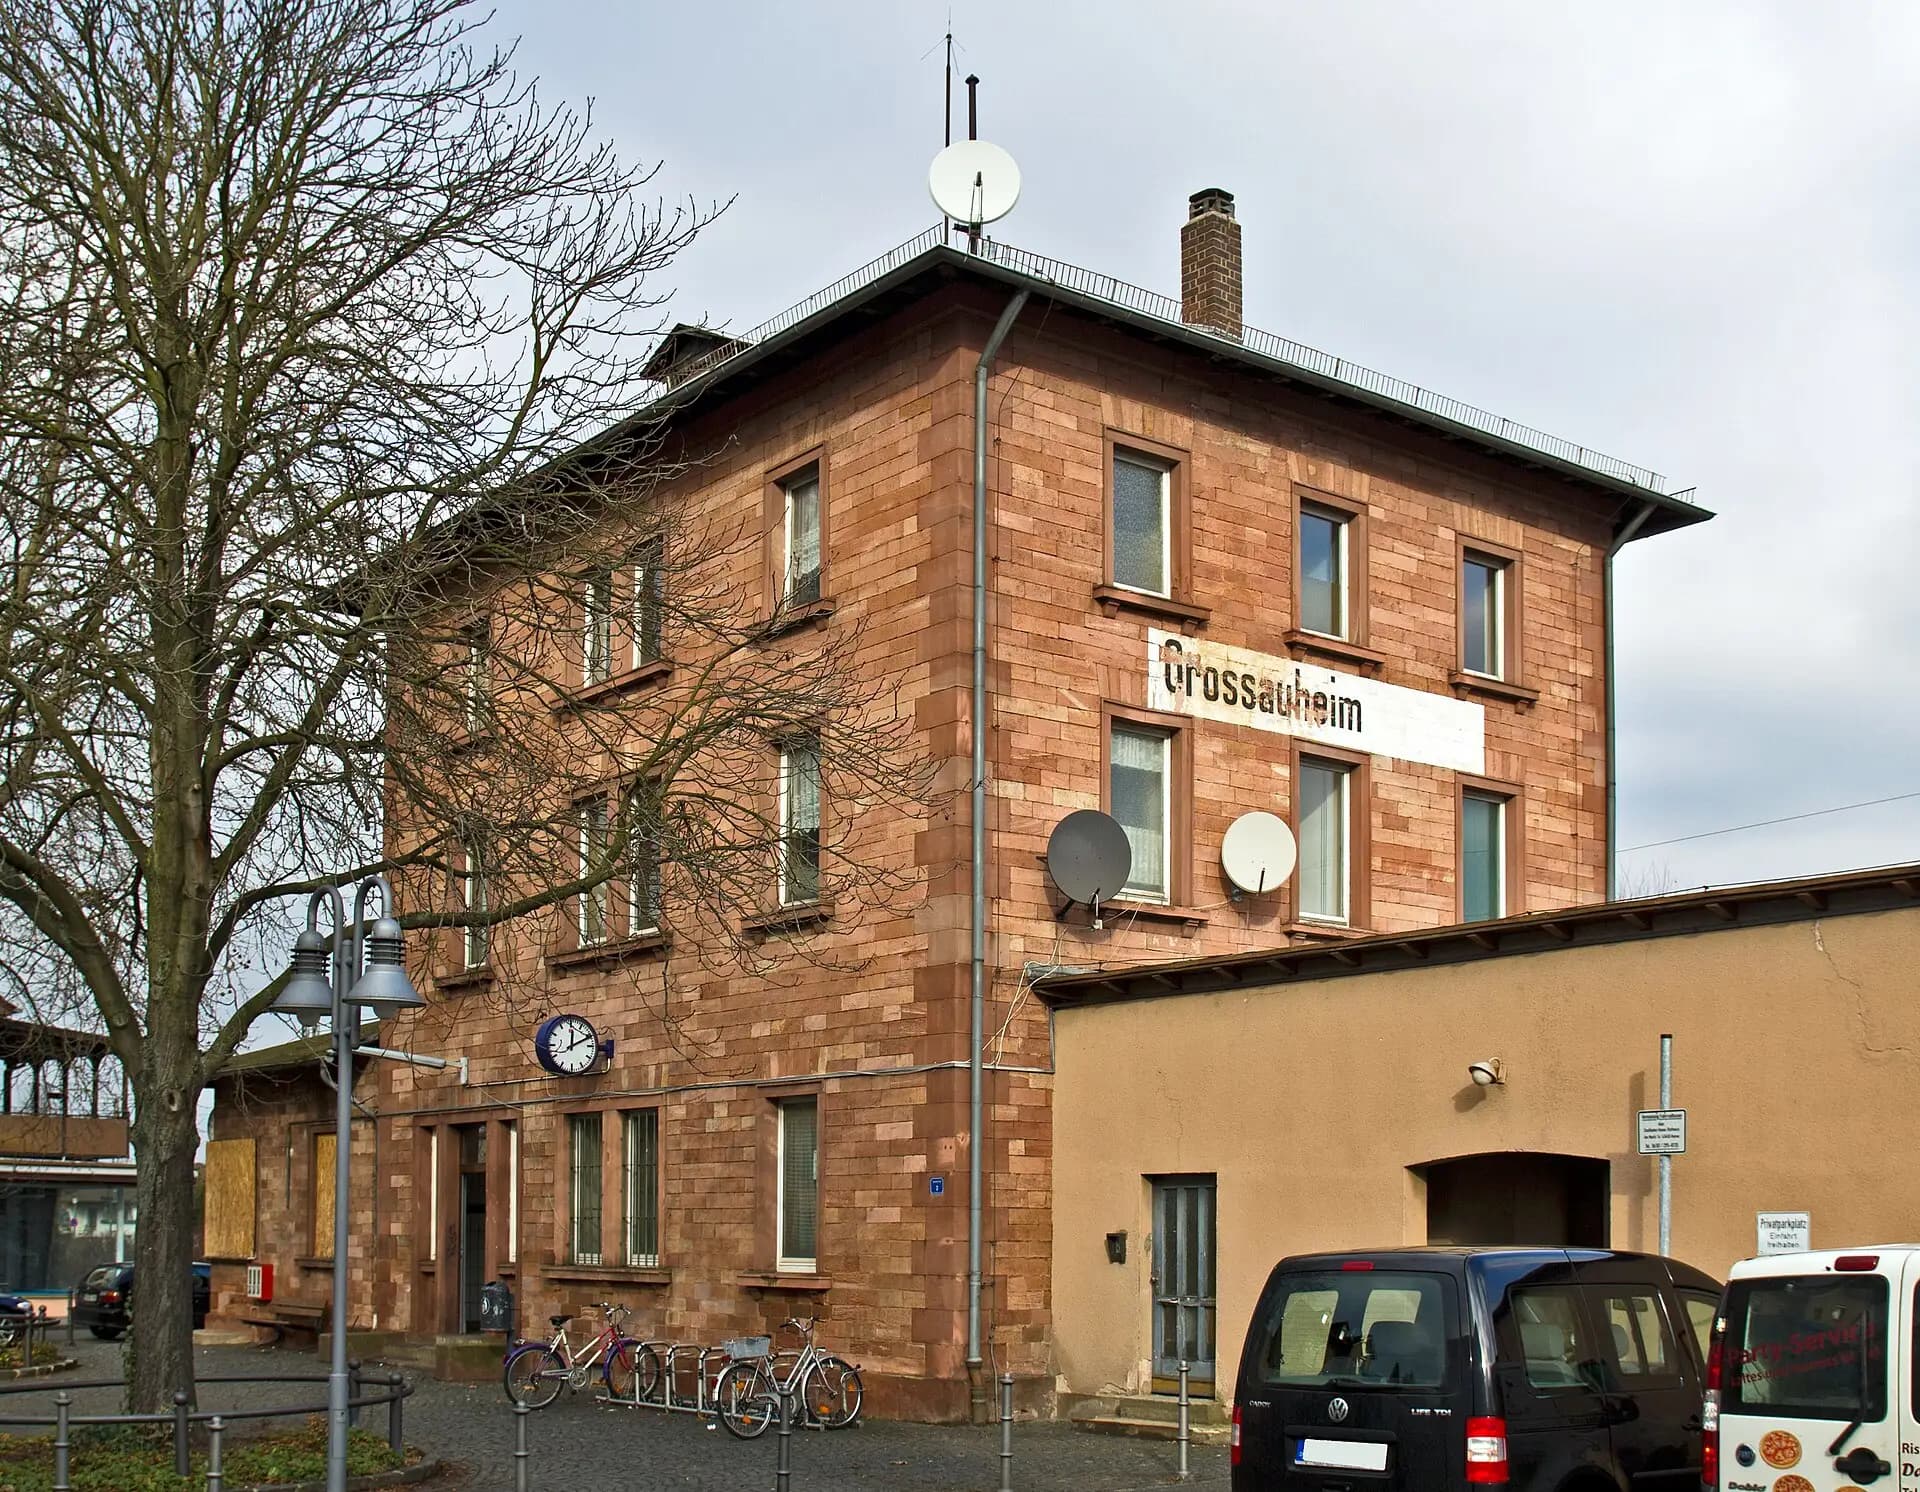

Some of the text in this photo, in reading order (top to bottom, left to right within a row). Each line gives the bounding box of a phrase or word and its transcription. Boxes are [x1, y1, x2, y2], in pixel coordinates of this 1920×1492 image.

[1760, 1217, 1807, 1231] Privatparkplatz
[1411, 1408, 1452, 1417] LIFE TDI
[1902, 1442, 1920, 1455] Ris
